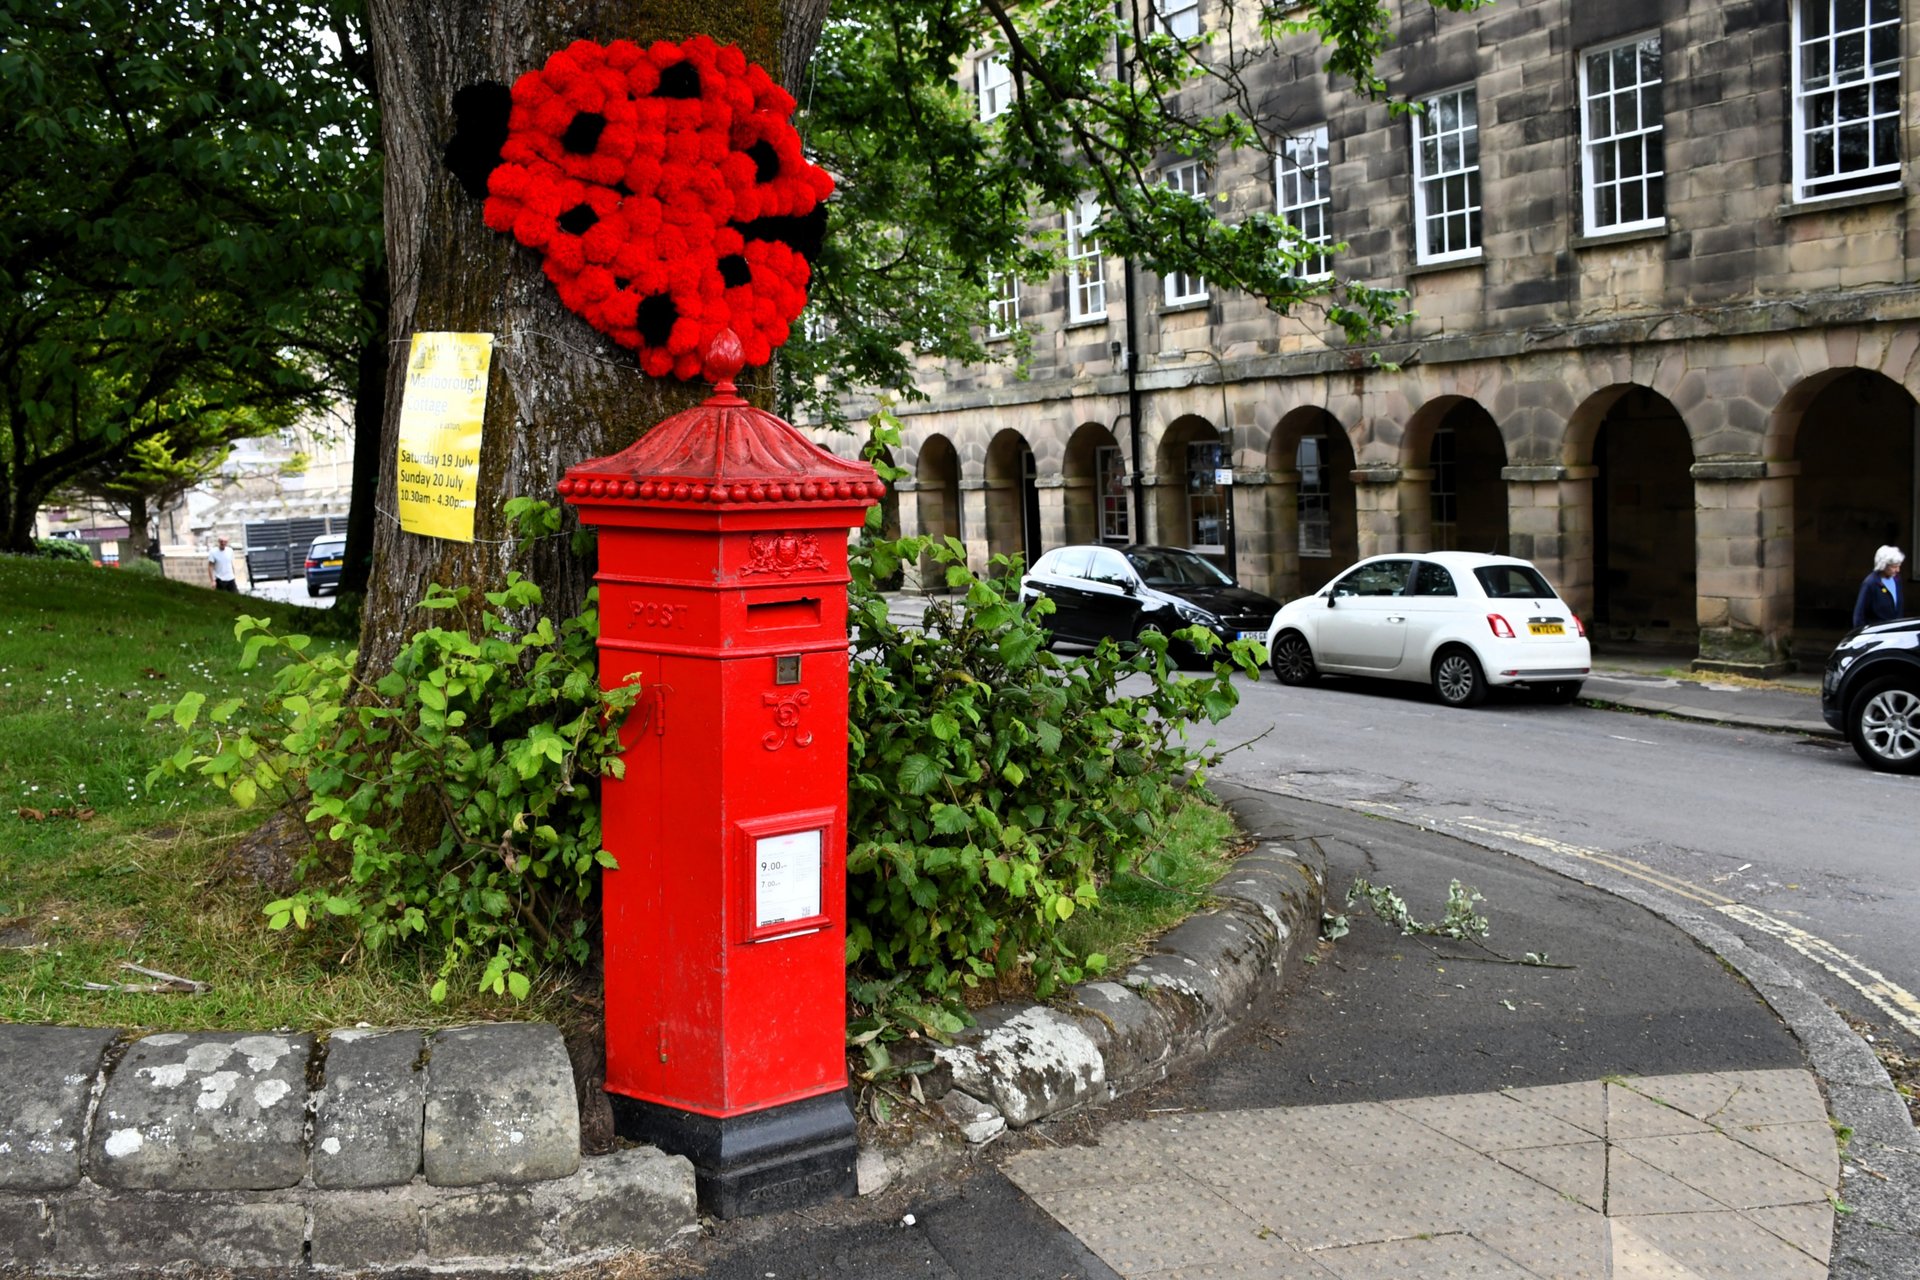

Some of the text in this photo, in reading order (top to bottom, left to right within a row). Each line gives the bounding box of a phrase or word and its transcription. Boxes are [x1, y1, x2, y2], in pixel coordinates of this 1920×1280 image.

[410, 372, 482, 394] Marlborough
[406, 395, 449, 416] Cottage
[401, 449, 474, 469] Saturday 19 July
[400, 469, 464, 492] Sunday 20 July
[400, 489, 431, 504] 10.30am
[629, 600, 688, 629] POST
